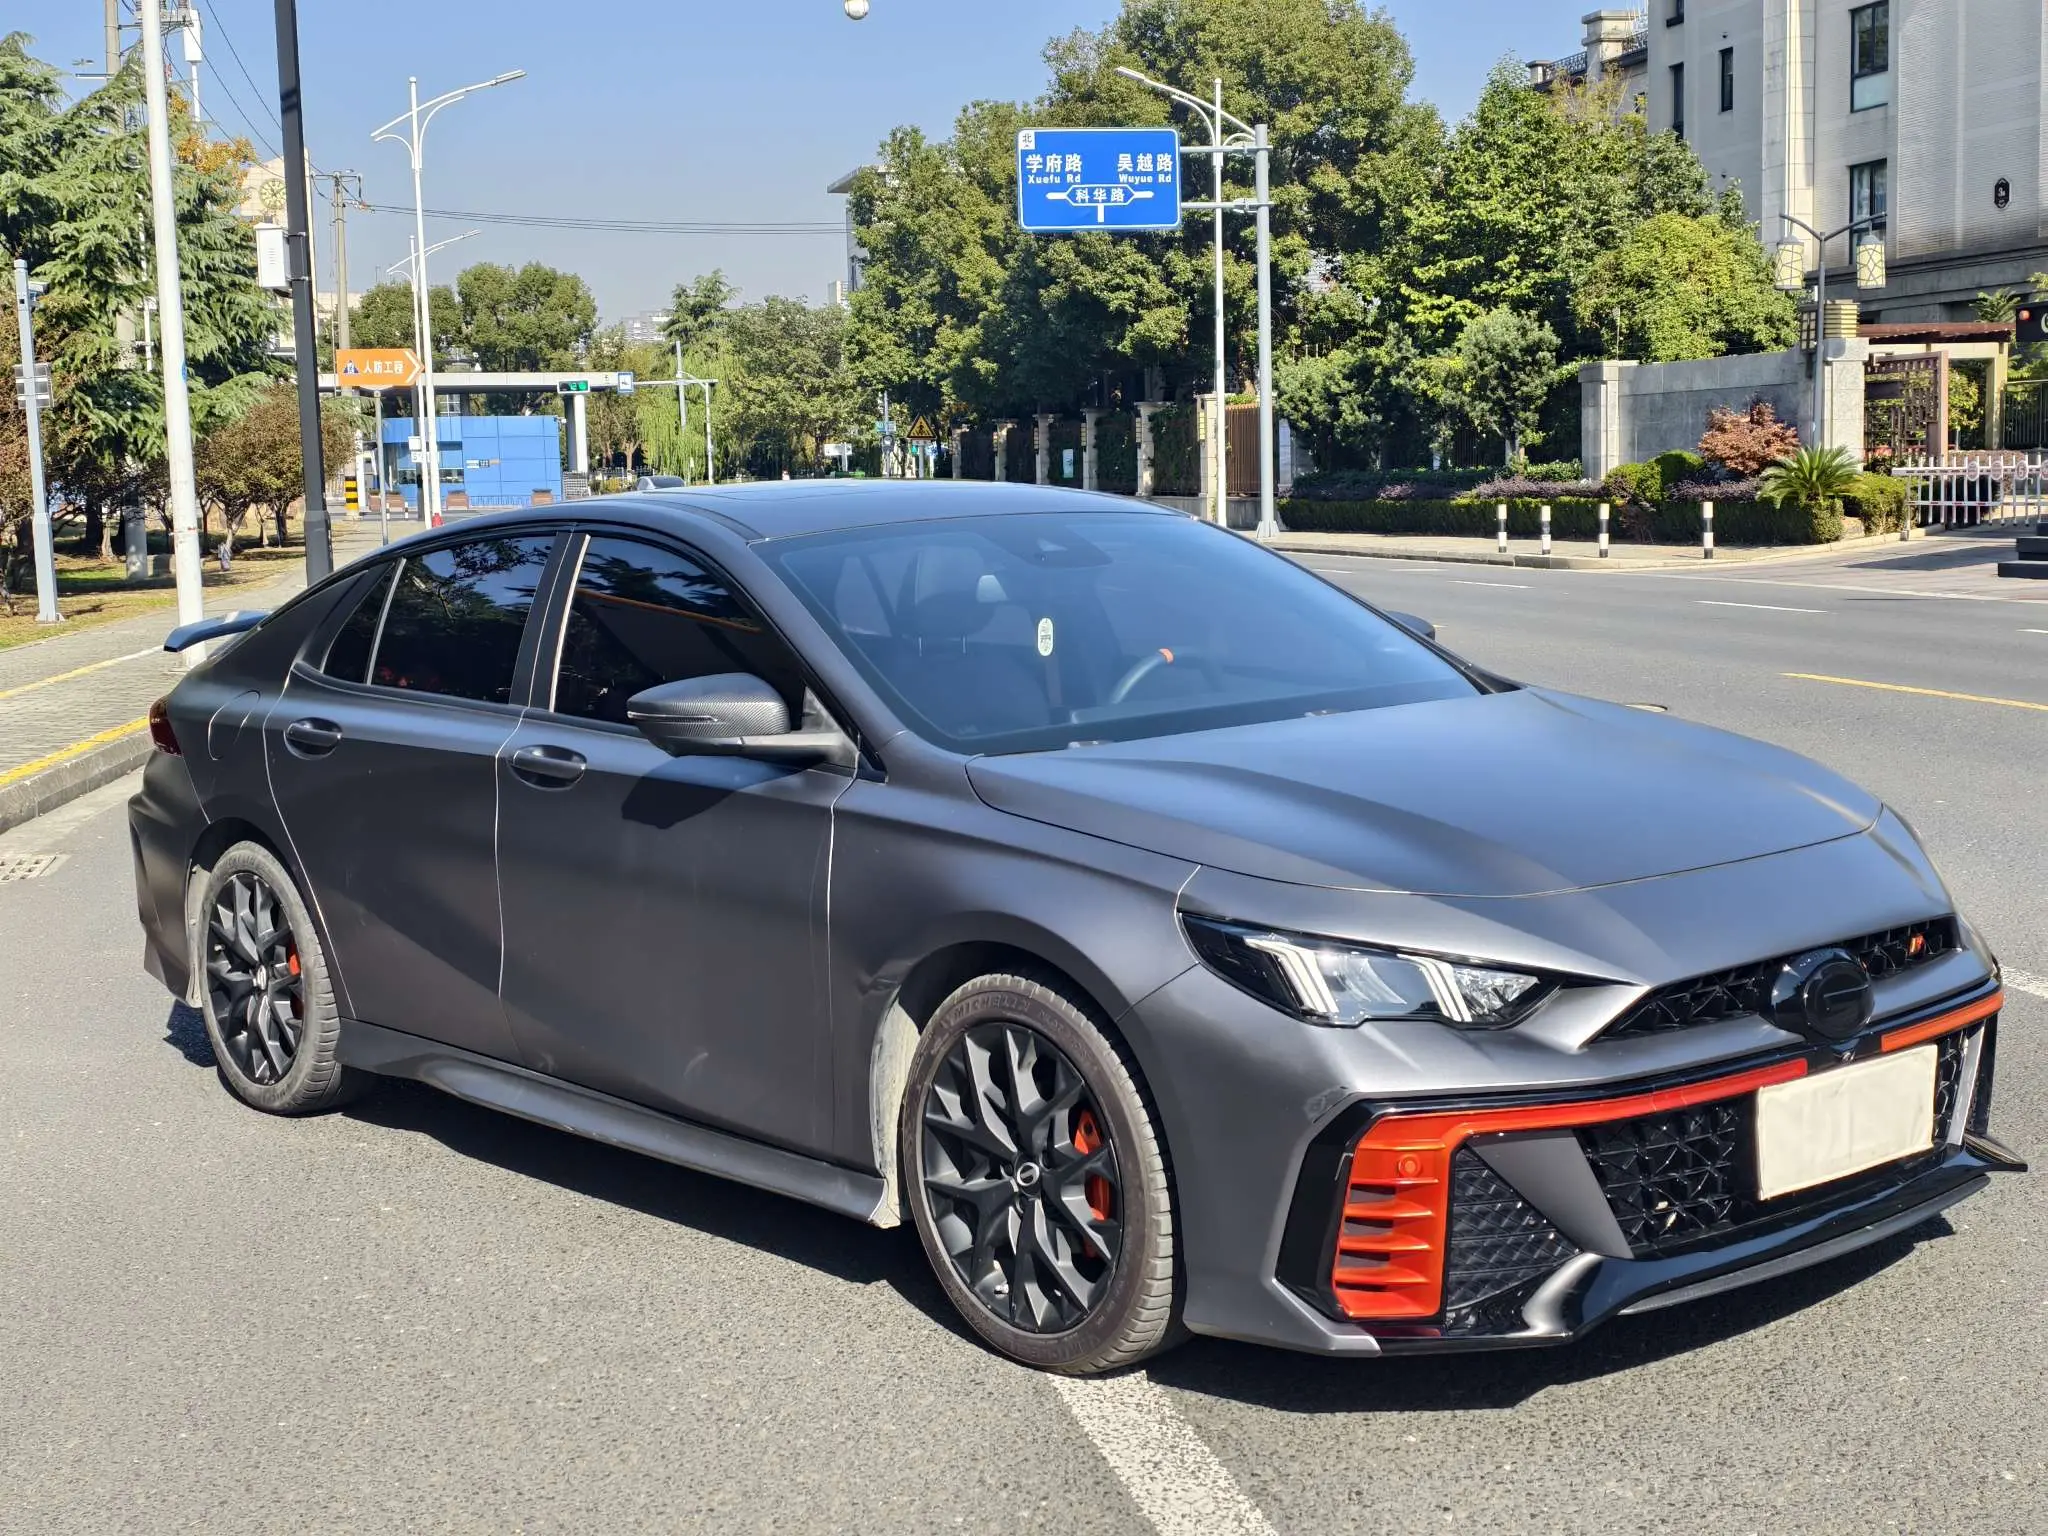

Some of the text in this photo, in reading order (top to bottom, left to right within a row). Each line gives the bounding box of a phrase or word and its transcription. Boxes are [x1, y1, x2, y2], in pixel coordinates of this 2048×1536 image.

[1022, 132, 1033, 144] 北
[1026, 154, 1082, 173] 学府路
[1117, 153, 1173, 172] 吴越路
[1028, 174, 1081, 184] Xuefu Rd
[1119, 174, 1172, 185] Wuyue Rd
[1075, 188, 1125, 203] 科华路
[363, 359, 404, 375] 人防工程
